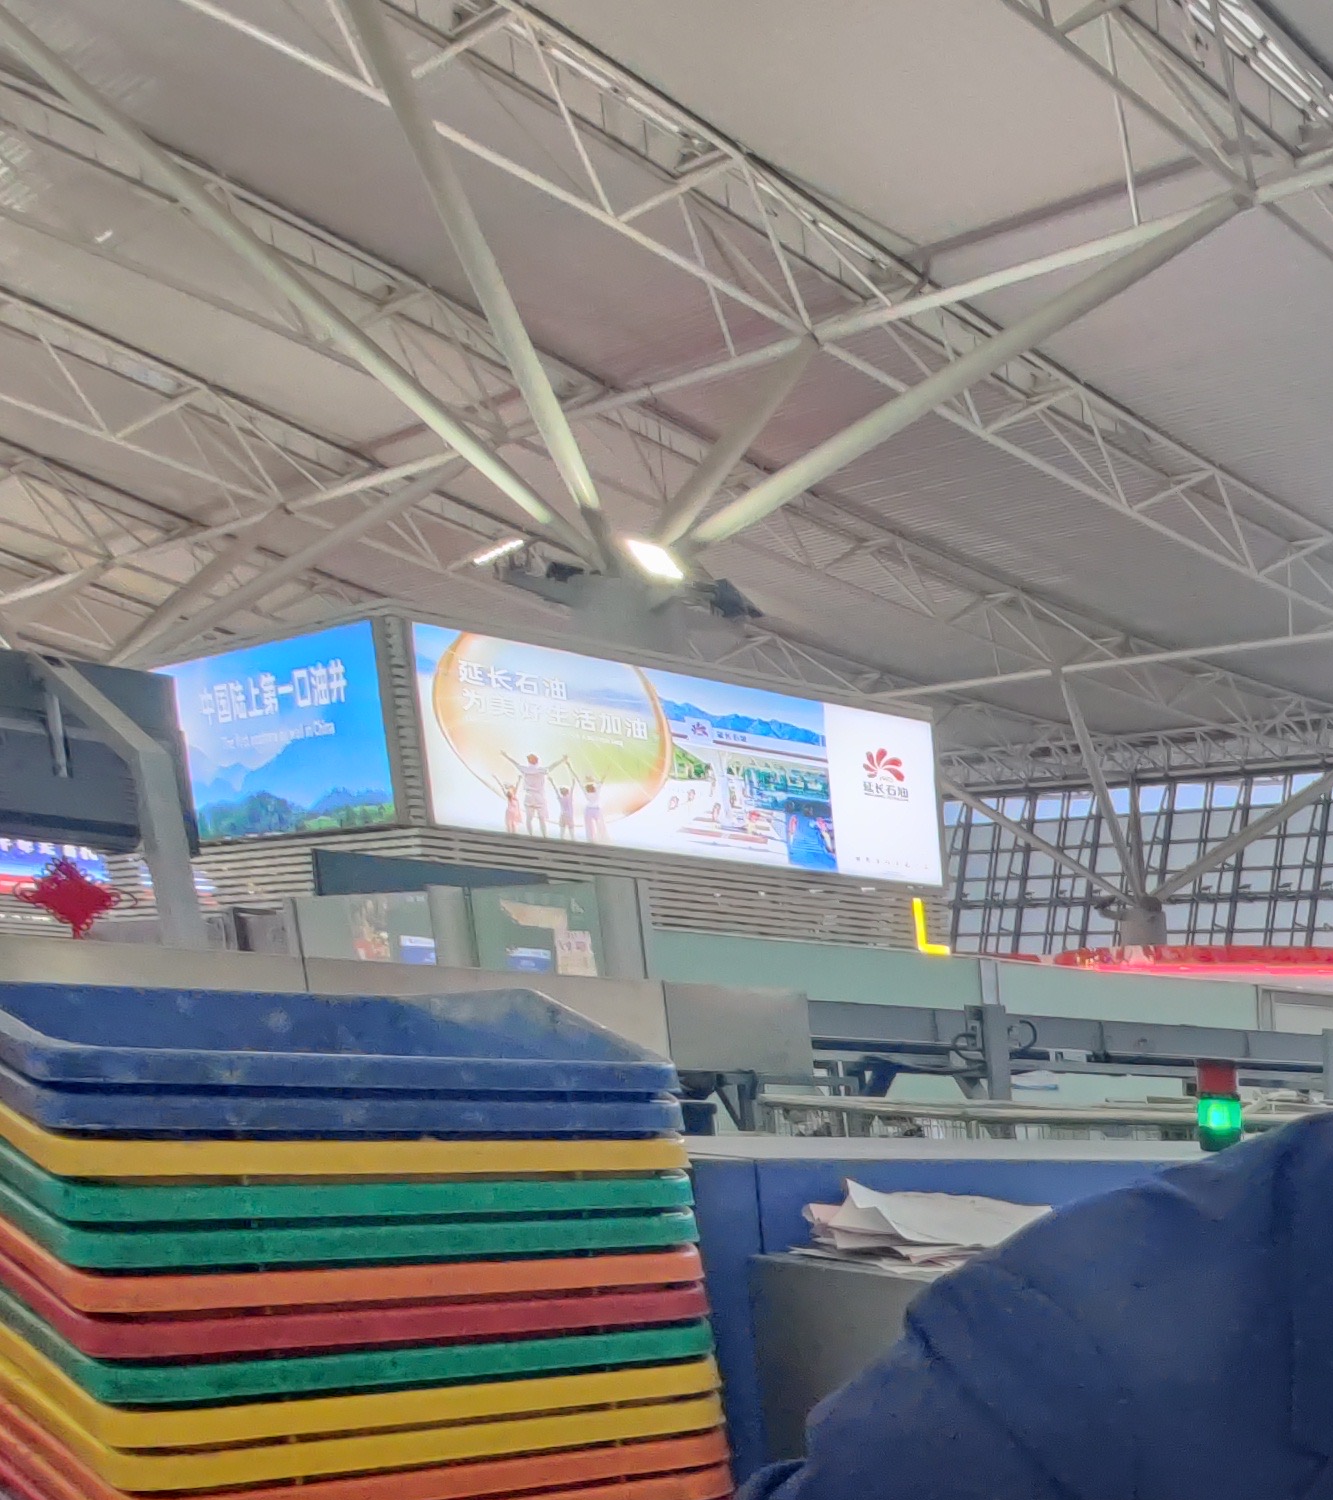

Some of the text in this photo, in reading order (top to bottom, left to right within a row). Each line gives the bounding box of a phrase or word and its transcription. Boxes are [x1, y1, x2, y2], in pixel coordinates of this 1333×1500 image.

[199, 658, 348, 726] 中国陆上第一口油井
[458, 659, 568, 701] 延长石油
[462, 688, 649, 742] 为美好生活加油
[863, 781, 909, 799] 延长石油
